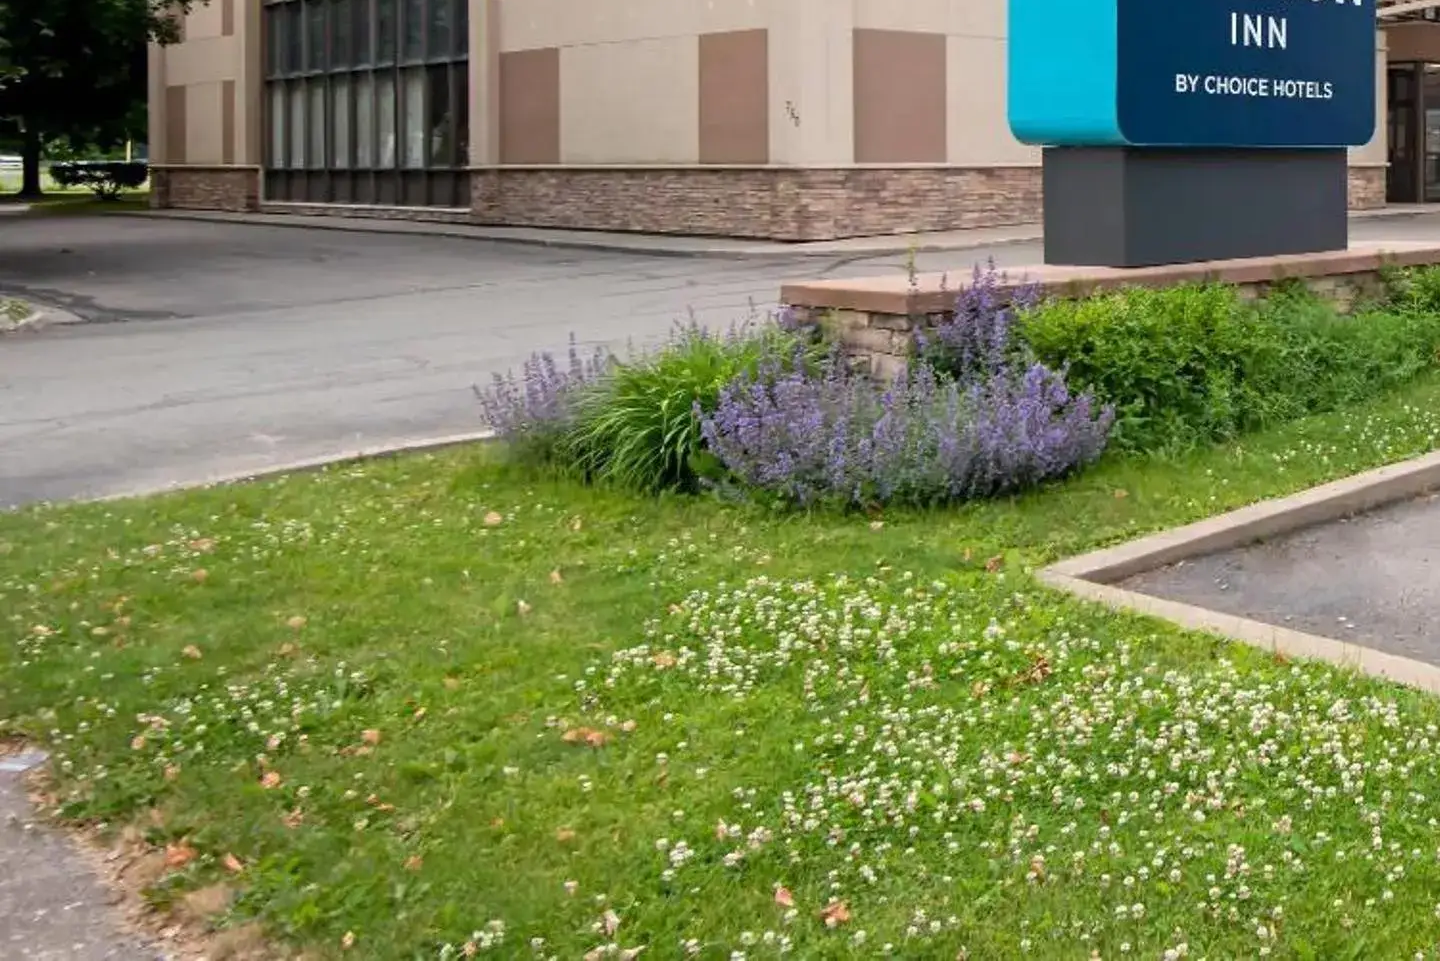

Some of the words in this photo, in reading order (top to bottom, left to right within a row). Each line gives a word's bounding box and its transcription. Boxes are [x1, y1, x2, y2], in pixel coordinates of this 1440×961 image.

[1231, 12, 1287, 49] INN
[1175, 74, 1199, 92] BY
[1204, 75, 1269, 96] CHOICE
[1273, 79, 1333, 99] HOTELS
